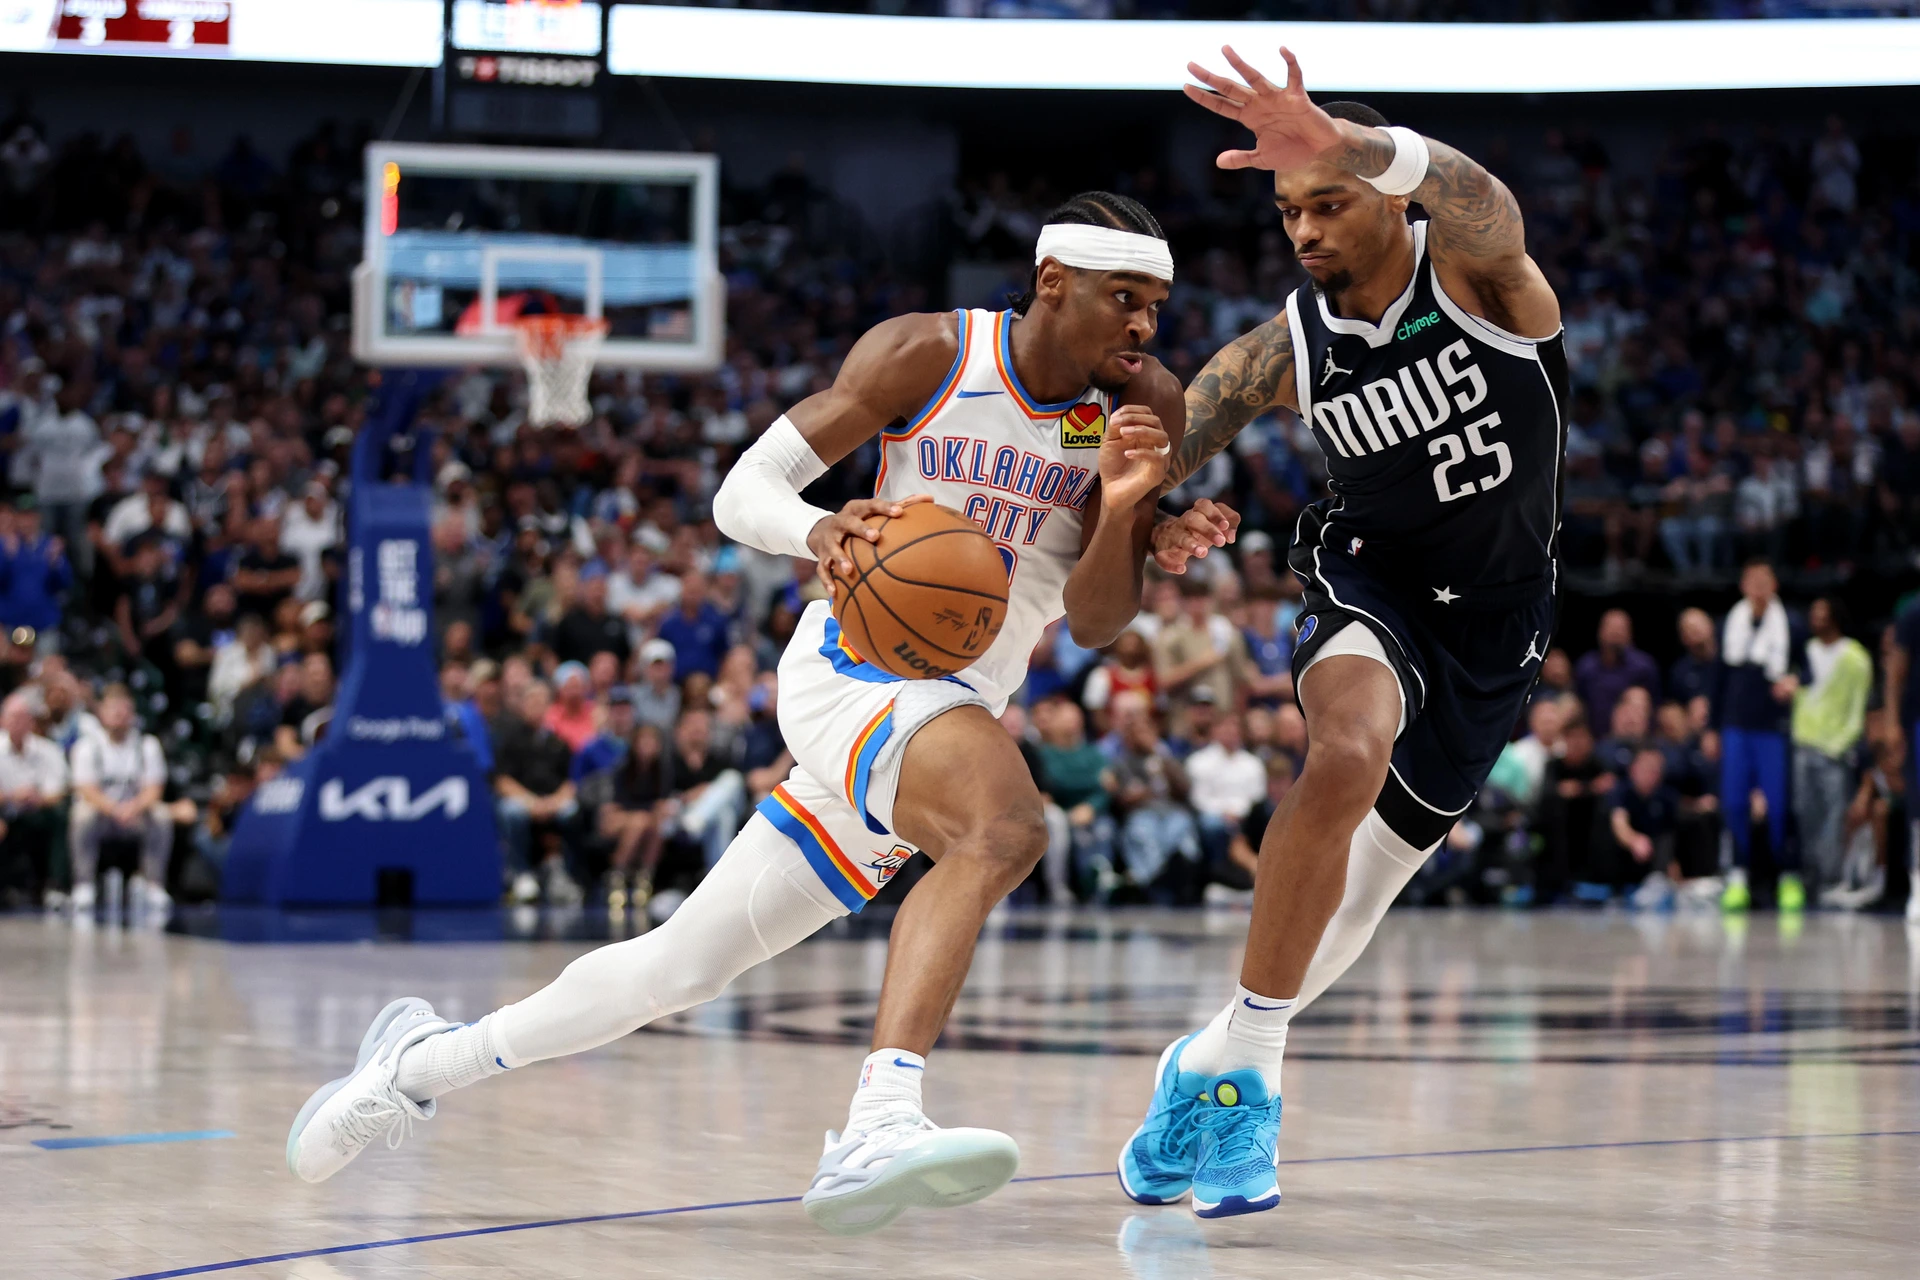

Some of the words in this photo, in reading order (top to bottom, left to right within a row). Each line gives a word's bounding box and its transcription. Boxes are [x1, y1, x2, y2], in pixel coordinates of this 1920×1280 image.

[1397, 311, 1440, 340] chime
[1427, 411, 1513, 502] 25
[964, 493, 1051, 545] CITY
